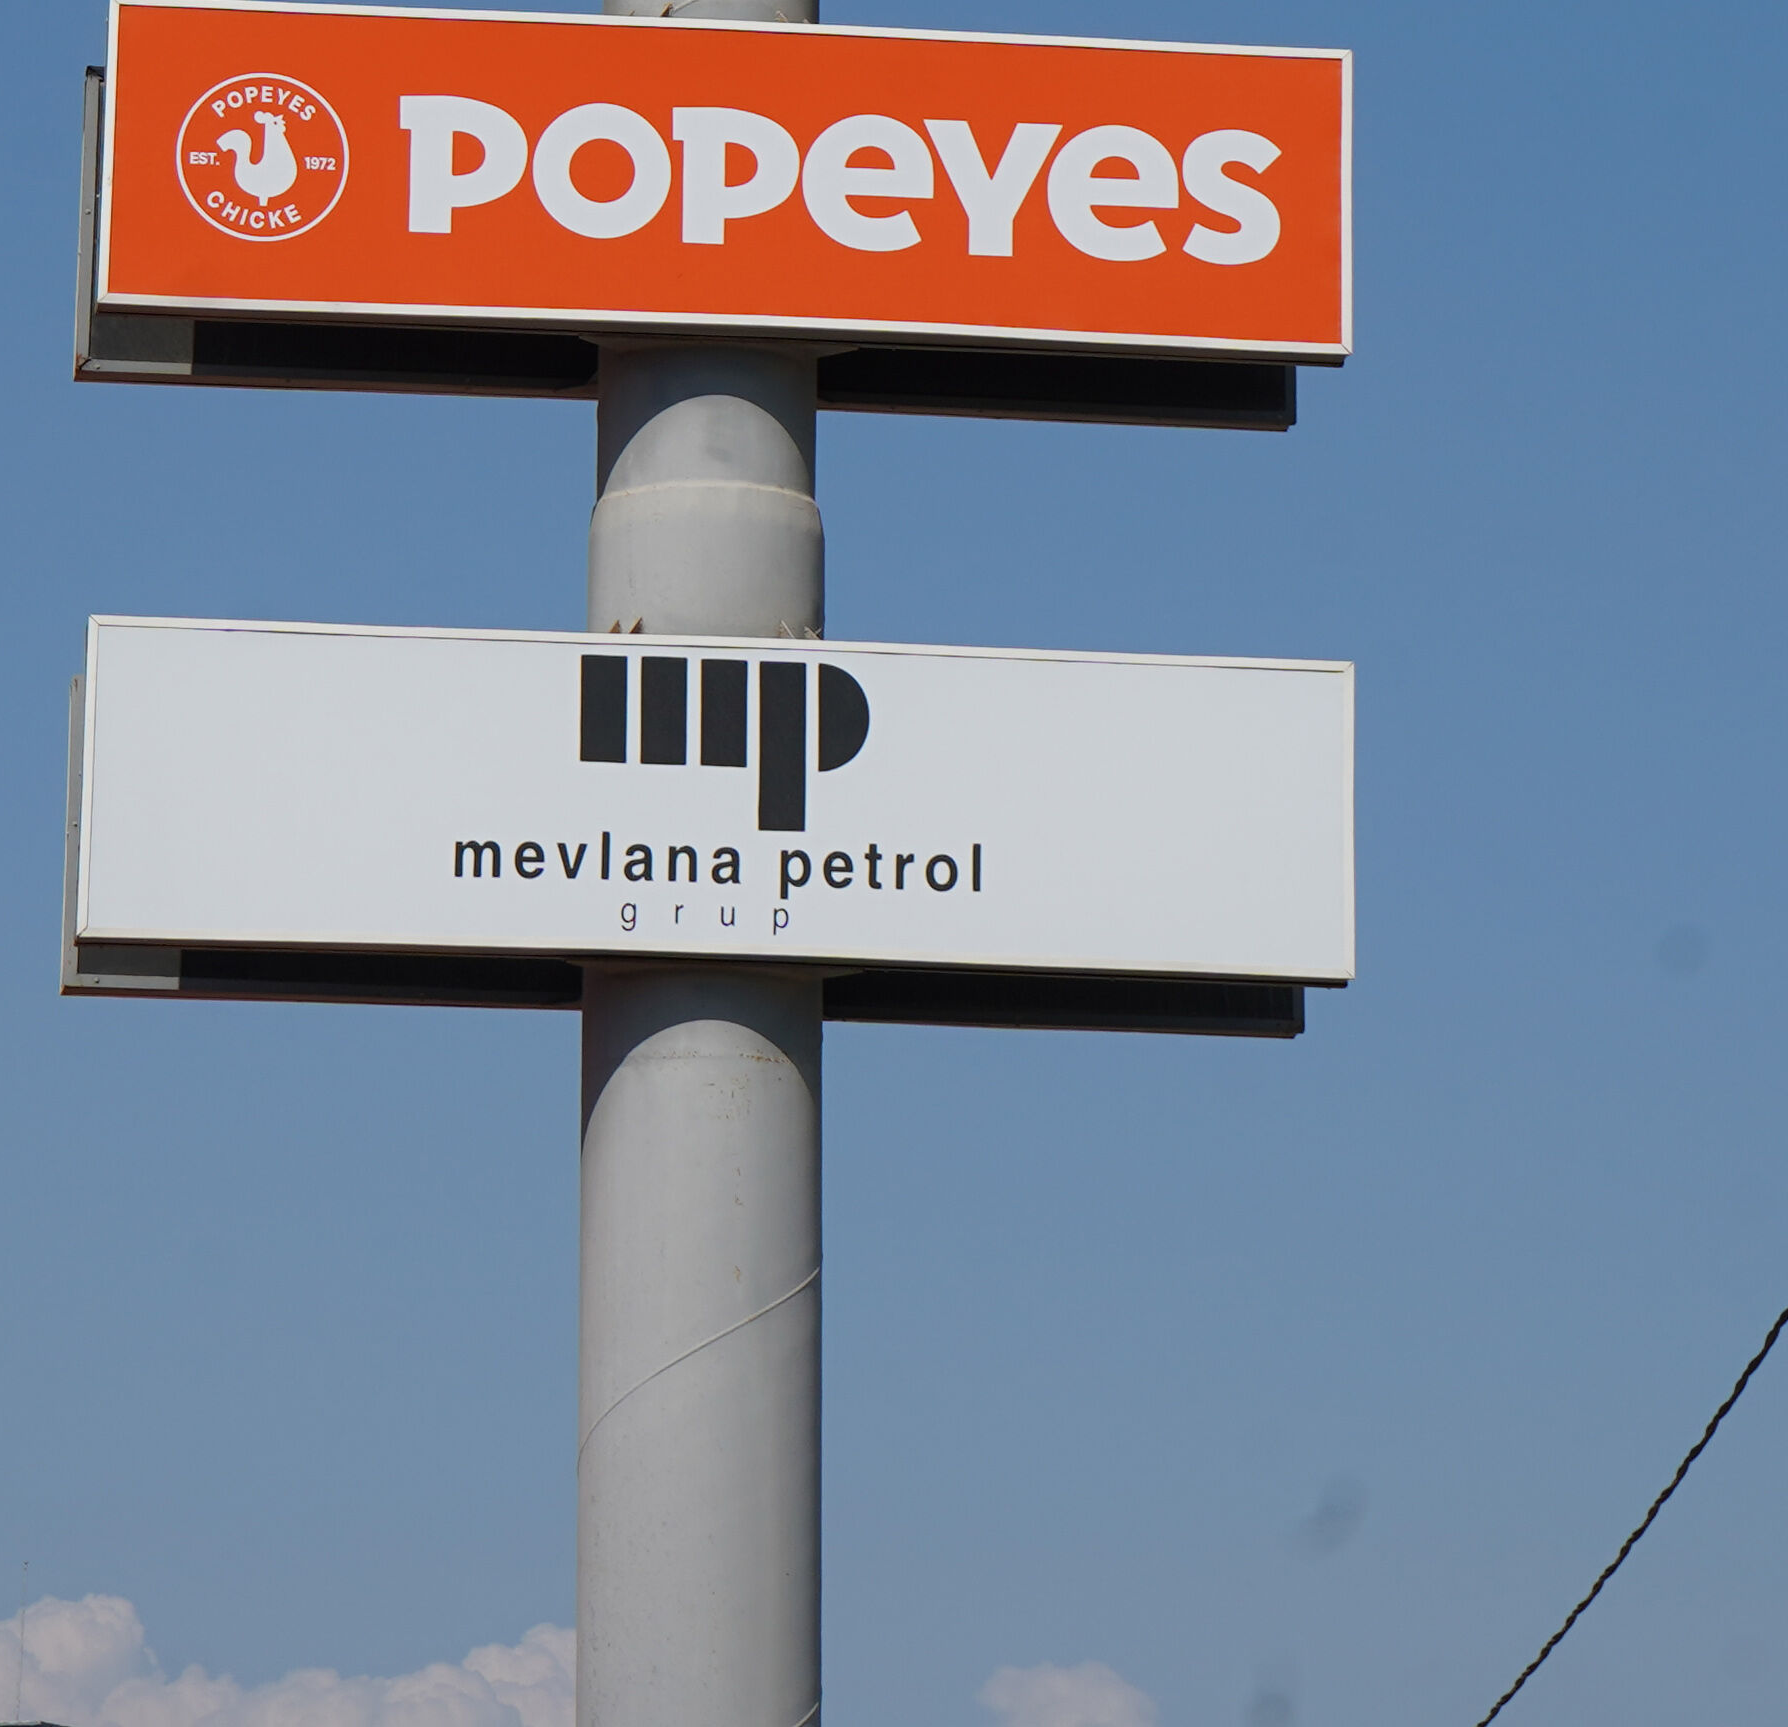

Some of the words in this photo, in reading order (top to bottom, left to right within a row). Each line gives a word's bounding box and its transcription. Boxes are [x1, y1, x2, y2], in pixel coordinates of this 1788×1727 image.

[211, 85, 316, 121] POPEYES
[189, 151, 220, 166] EST.
[304, 156, 336, 171] 1972
[206, 190, 301, 229] CHICKE
[454, 831, 741, 885] mevlana
[780, 843, 982, 900] petrol
[620, 902, 789, 936] grup
